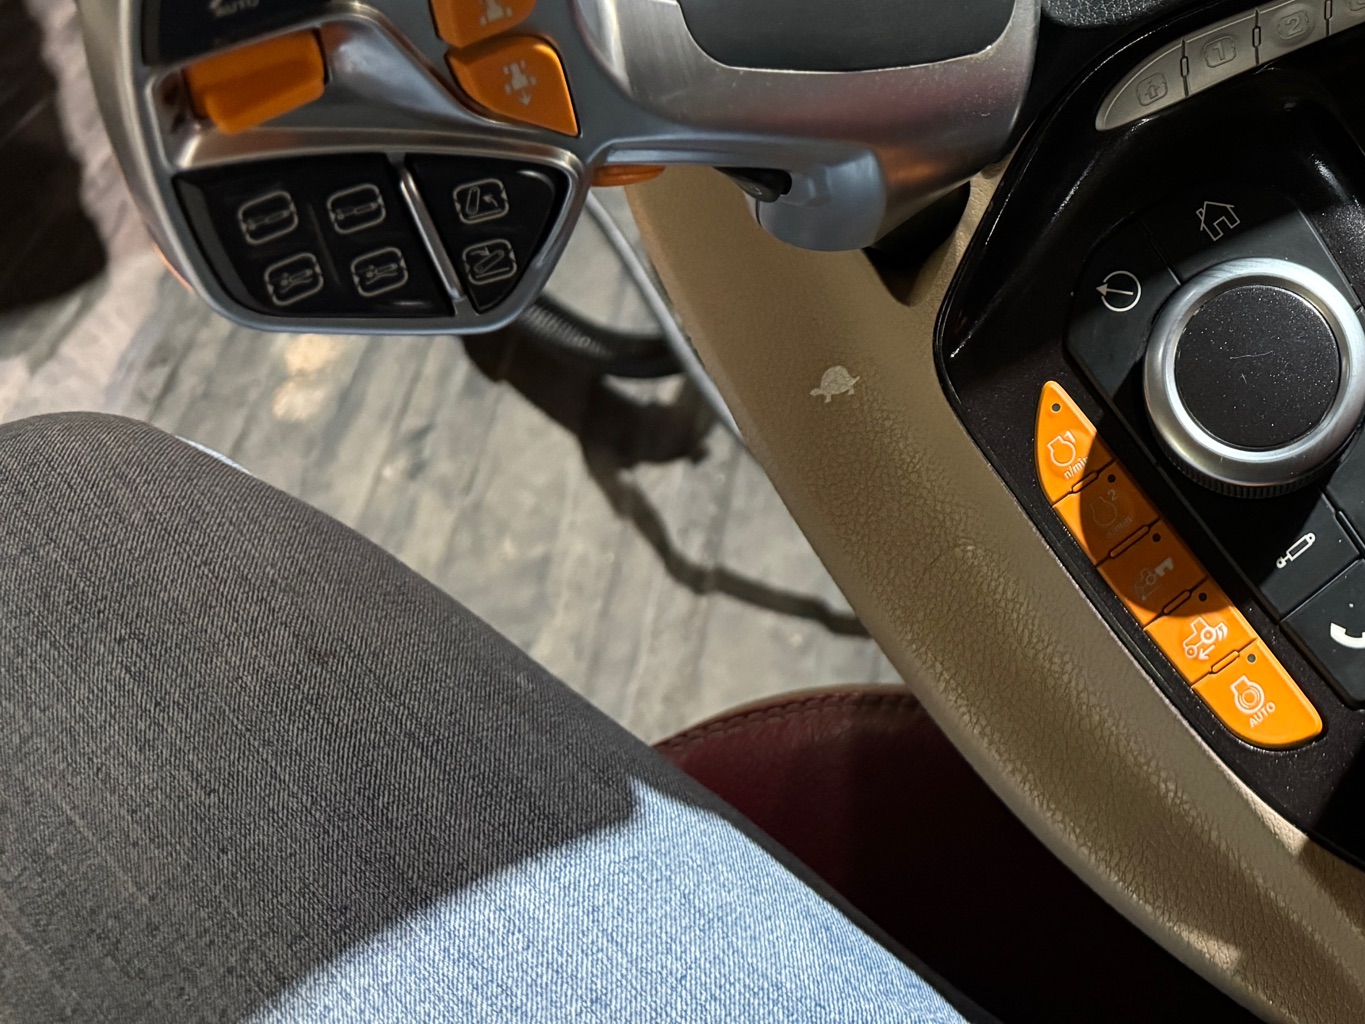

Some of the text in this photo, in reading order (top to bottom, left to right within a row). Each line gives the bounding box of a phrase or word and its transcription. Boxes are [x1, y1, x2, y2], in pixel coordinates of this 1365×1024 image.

[1286, 16, 1301, 36] 2
[1212, 44, 1227, 62] 1
[1064, 430, 1076, 443] 1
[1107, 489, 1117, 501] 2
[1249, 701, 1276, 729] AUTO
